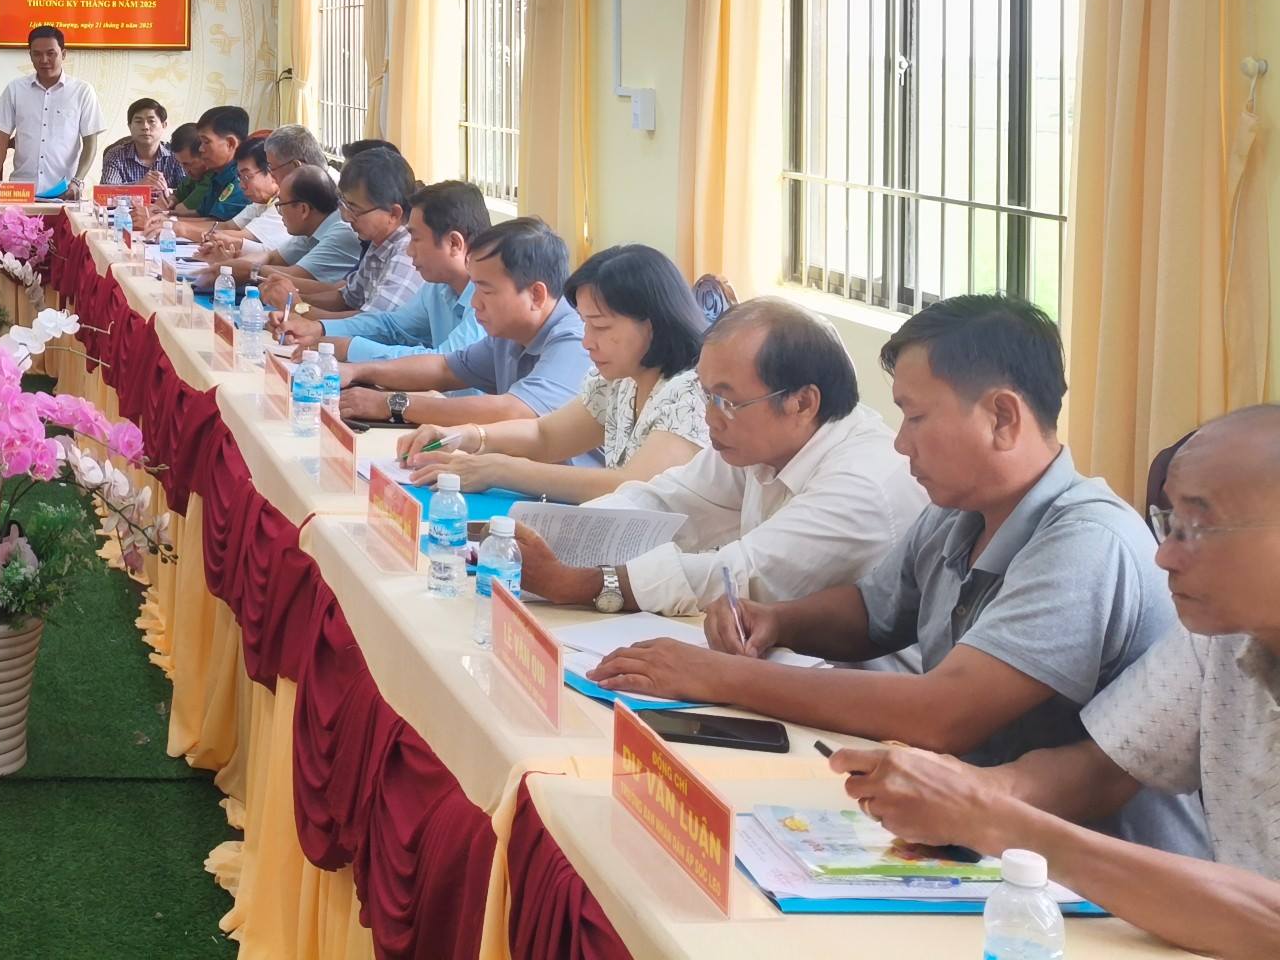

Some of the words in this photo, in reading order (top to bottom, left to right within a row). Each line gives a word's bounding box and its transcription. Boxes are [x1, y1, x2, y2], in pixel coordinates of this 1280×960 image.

[80, 0, 111, 8] THÁNG
[140, 0, 156, 8] 2025
[651, 750, 673, 782] ĐỒNG
[674, 775, 689, 797] CHÍ
[646, 767, 677, 818] VĂN
[679, 801, 721, 865] LUẬN
